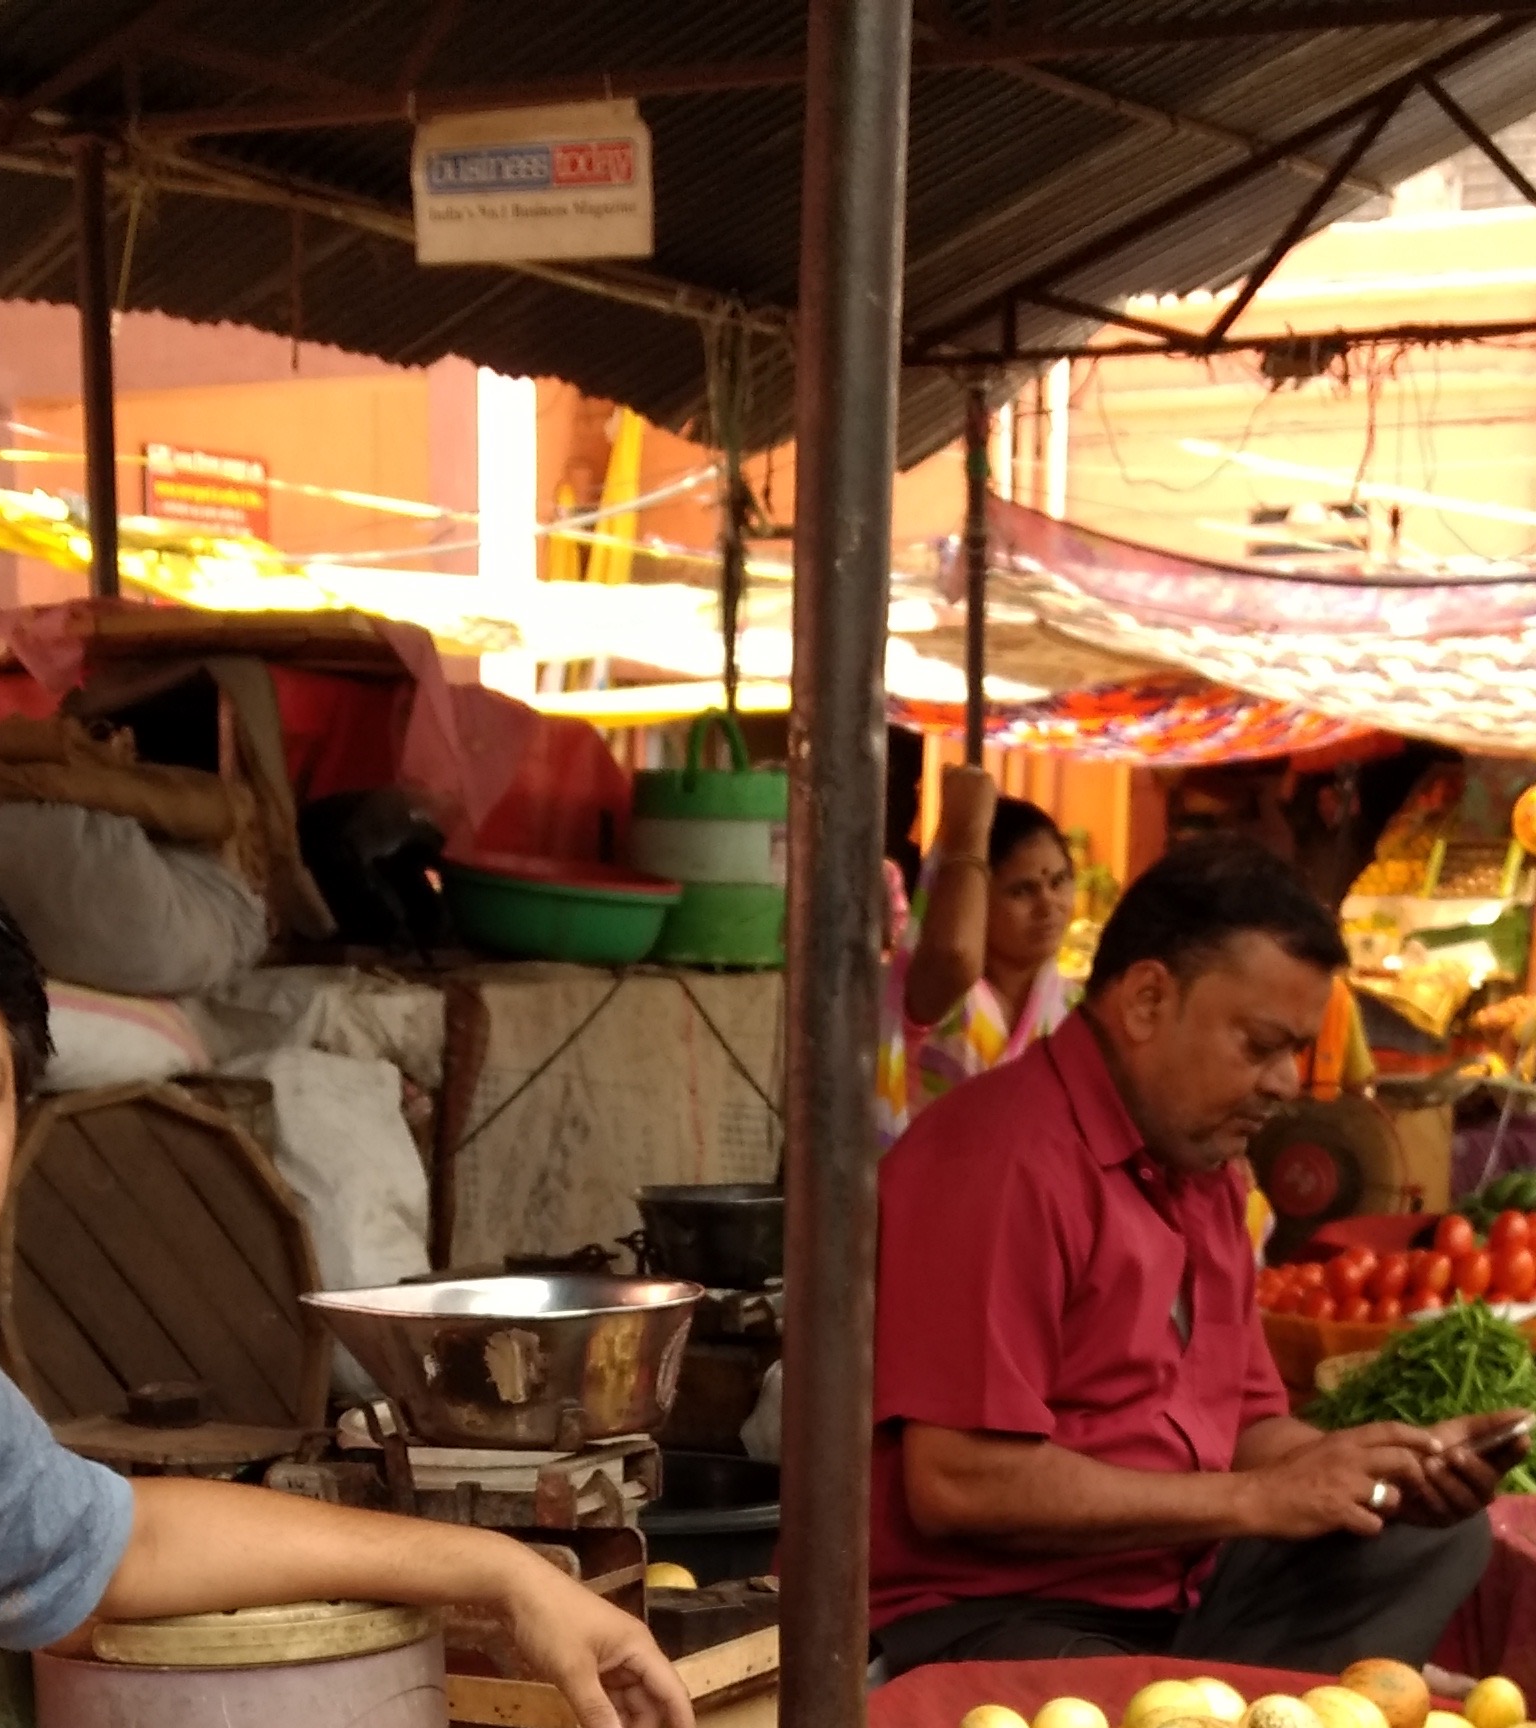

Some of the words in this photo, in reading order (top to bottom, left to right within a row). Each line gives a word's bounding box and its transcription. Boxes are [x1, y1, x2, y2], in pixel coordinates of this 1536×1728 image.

[429, 204, 473, 222] India's
[511, 202, 568, 219] Business
[573, 200, 636, 219] Magazine
